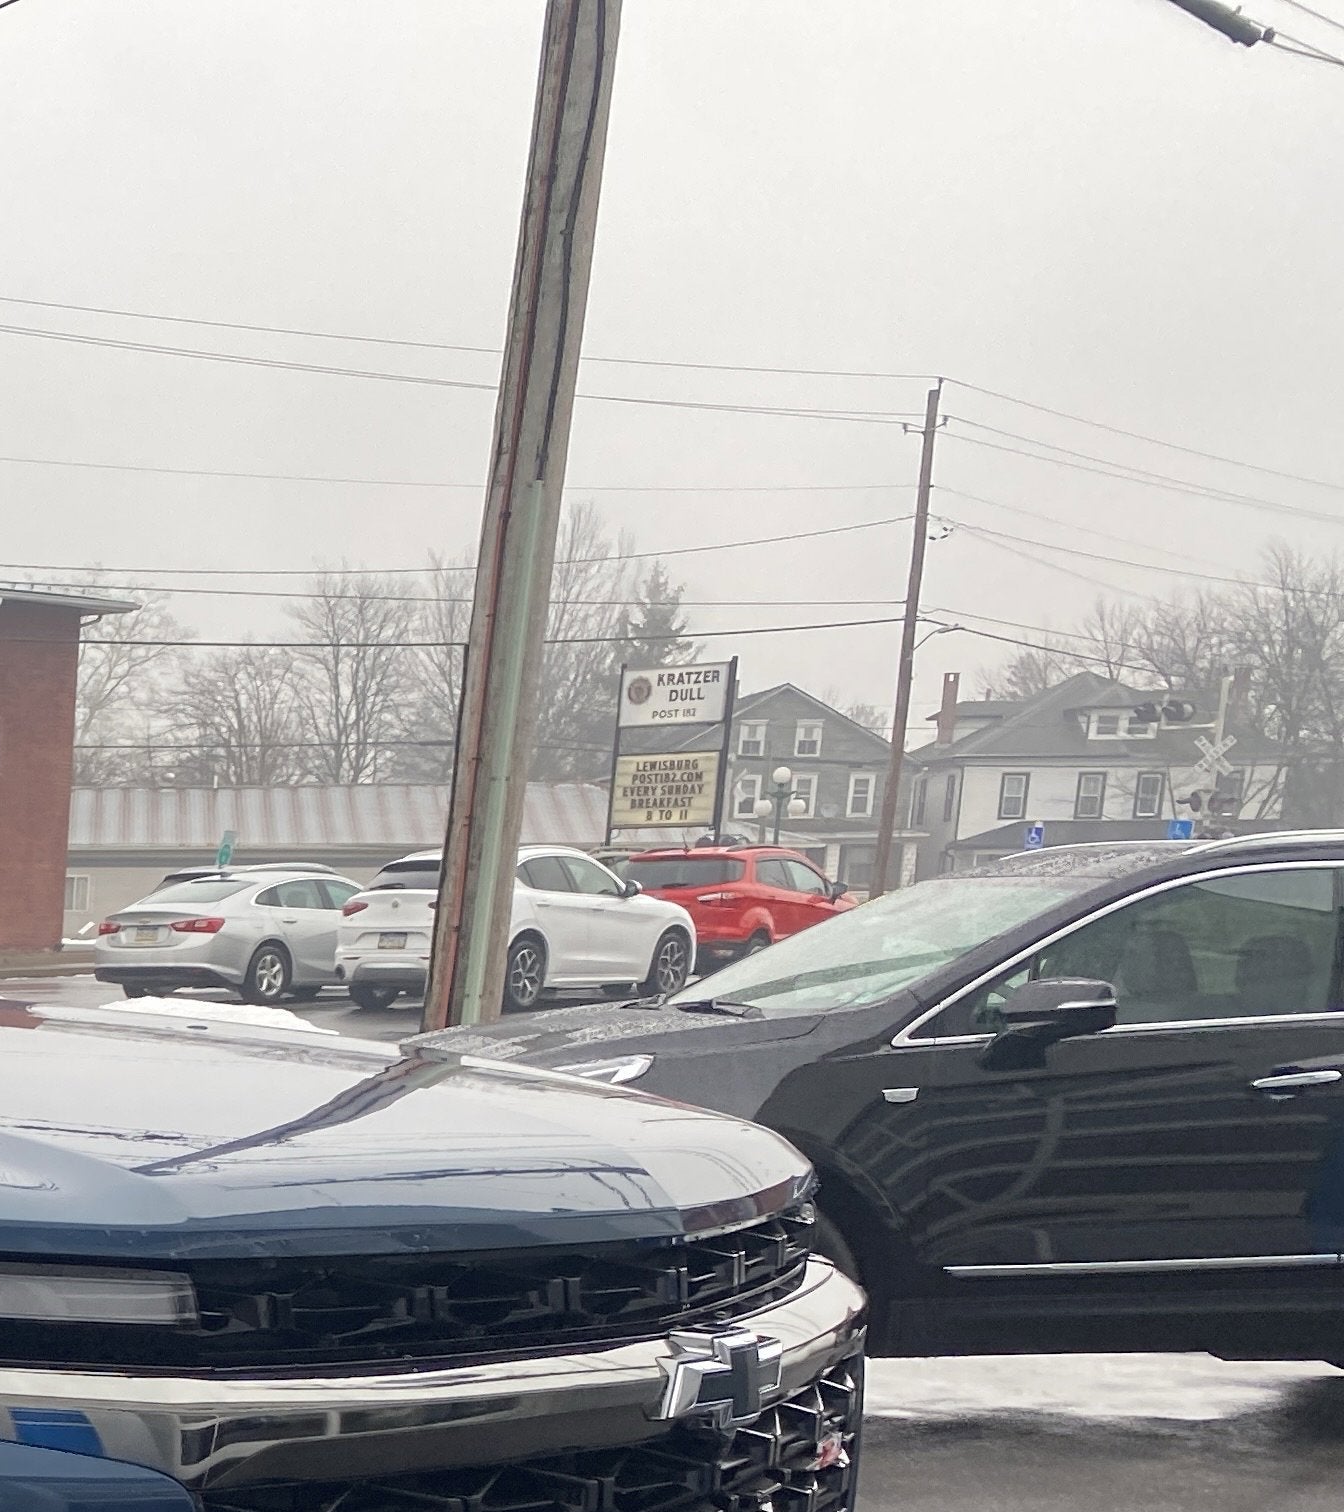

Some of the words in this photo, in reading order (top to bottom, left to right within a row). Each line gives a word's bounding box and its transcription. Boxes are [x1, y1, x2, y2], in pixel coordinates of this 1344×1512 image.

[657, 670, 720, 687] KRATZER
[668, 688, 705, 702] DULL
[652, 708, 681, 719] POST
[636, 758, 699, 772] LEWISBURG
[631, 771, 704, 785] POST182.COM
[623, 785, 658, 797] EVERY
[660, 784, 704, 796] SUNDAY
[630, 797, 694, 809] BREAKFAST
[658, 810, 673, 821] TO
